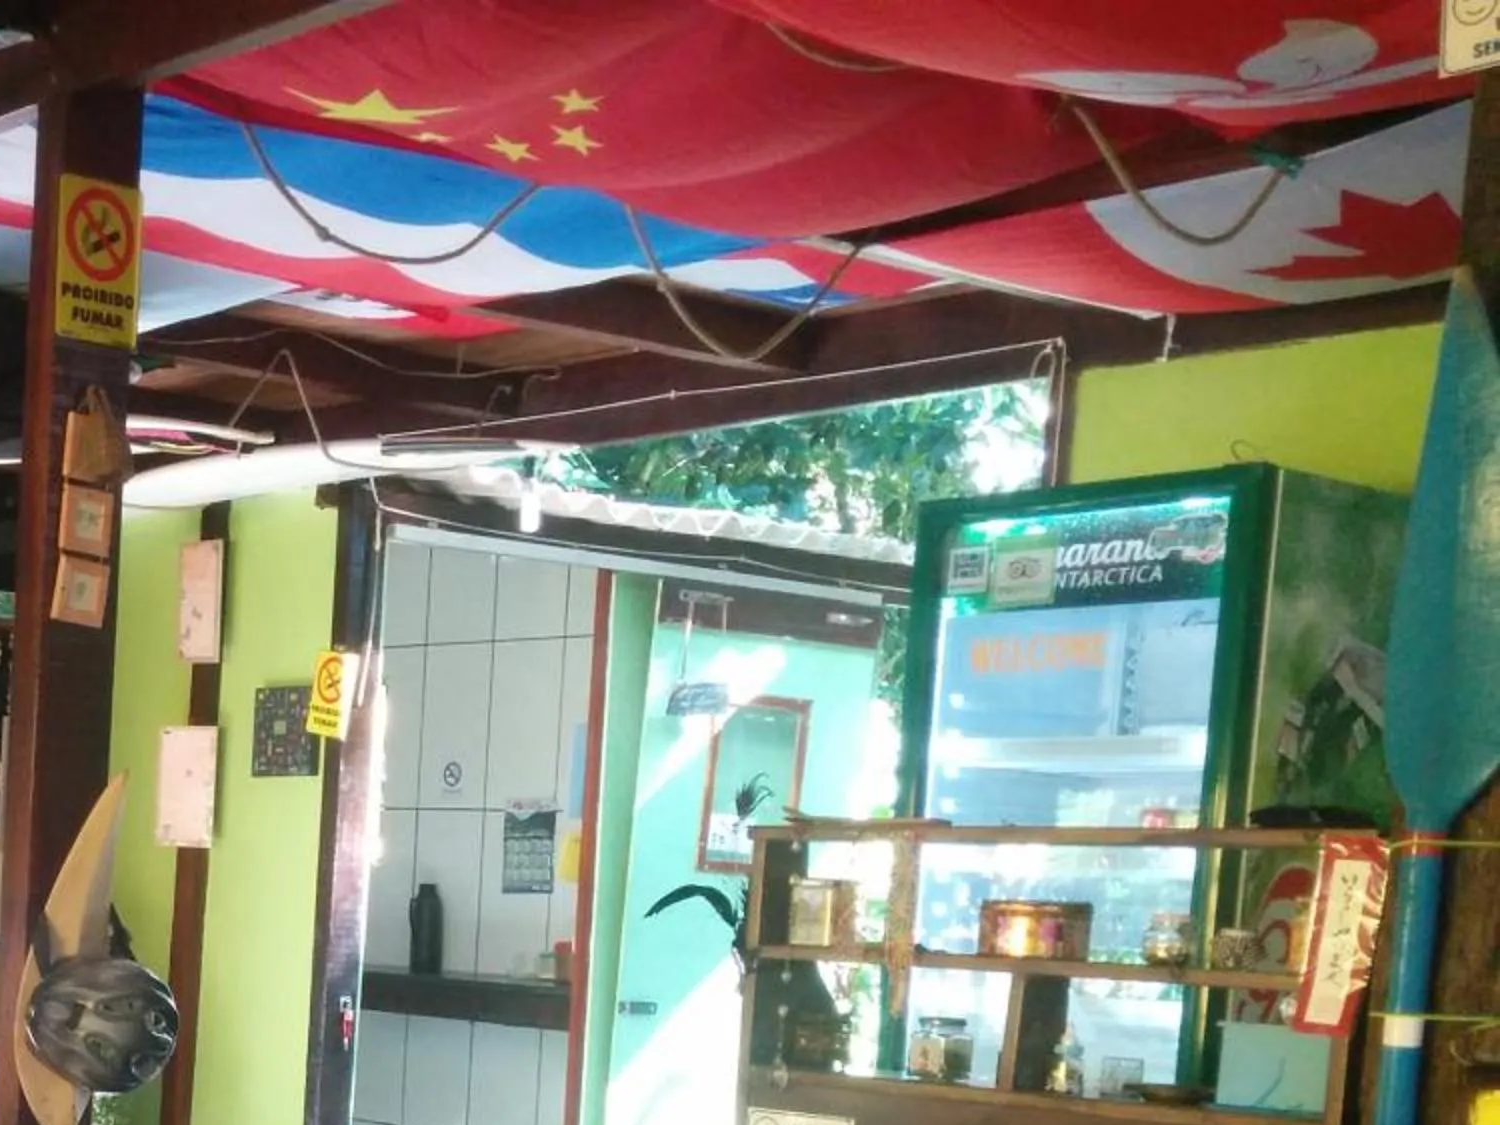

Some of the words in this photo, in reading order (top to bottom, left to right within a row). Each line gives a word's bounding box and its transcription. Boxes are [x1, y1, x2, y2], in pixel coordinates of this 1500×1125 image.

[61, 281, 135, 310] PROIBIDO
[71, 306, 124, 329] FUMAR
[1055, 564, 1164, 589] NTARCTICA
